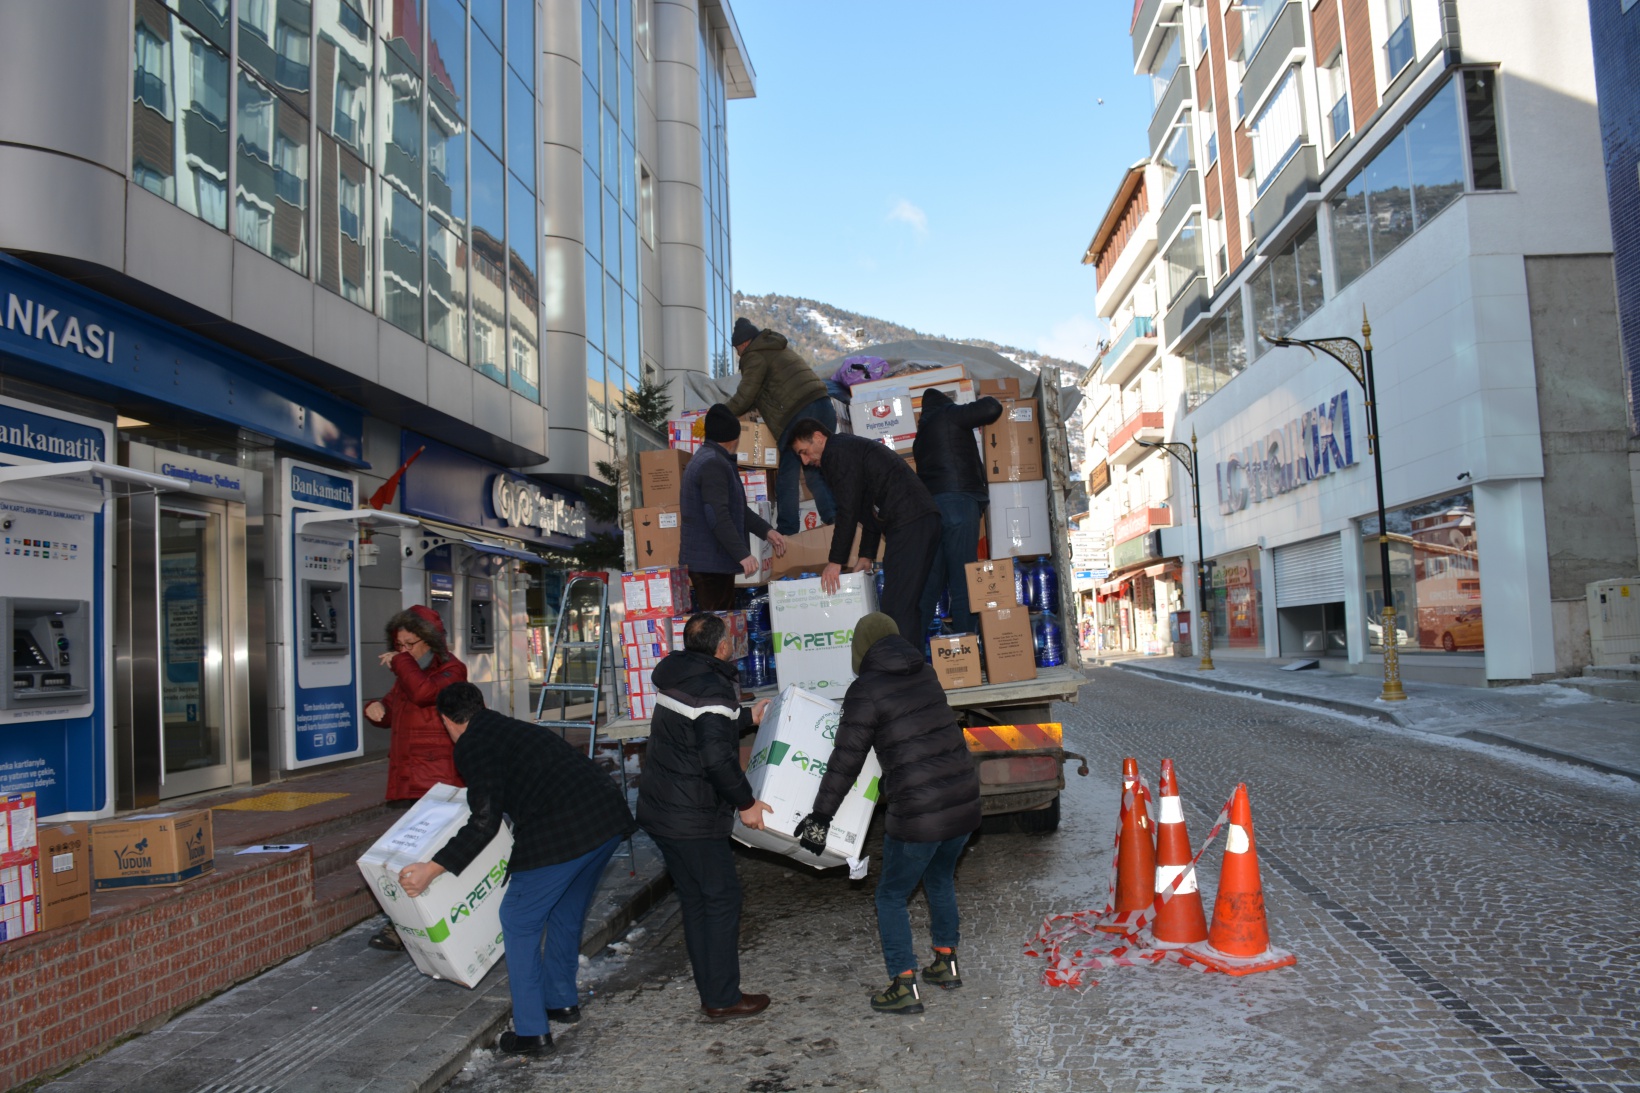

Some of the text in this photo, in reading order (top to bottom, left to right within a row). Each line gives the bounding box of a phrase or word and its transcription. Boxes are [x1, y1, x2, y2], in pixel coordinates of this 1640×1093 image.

[0, 292, 115, 364] NKASI
[0, 424, 101, 462] ankamatik
[292, 474, 352, 503] Bankamatik
[9, 505, 37, 515] KARTLARIN
[14, 758, 45, 769] kartlarıyla
[1, 777, 56, 792] borcunuzu ödeyin.
[8, 771, 29, 782] yatırın
[37, 767, 56, 778] çekin,
[113, 844, 152, 870] YUDUM
